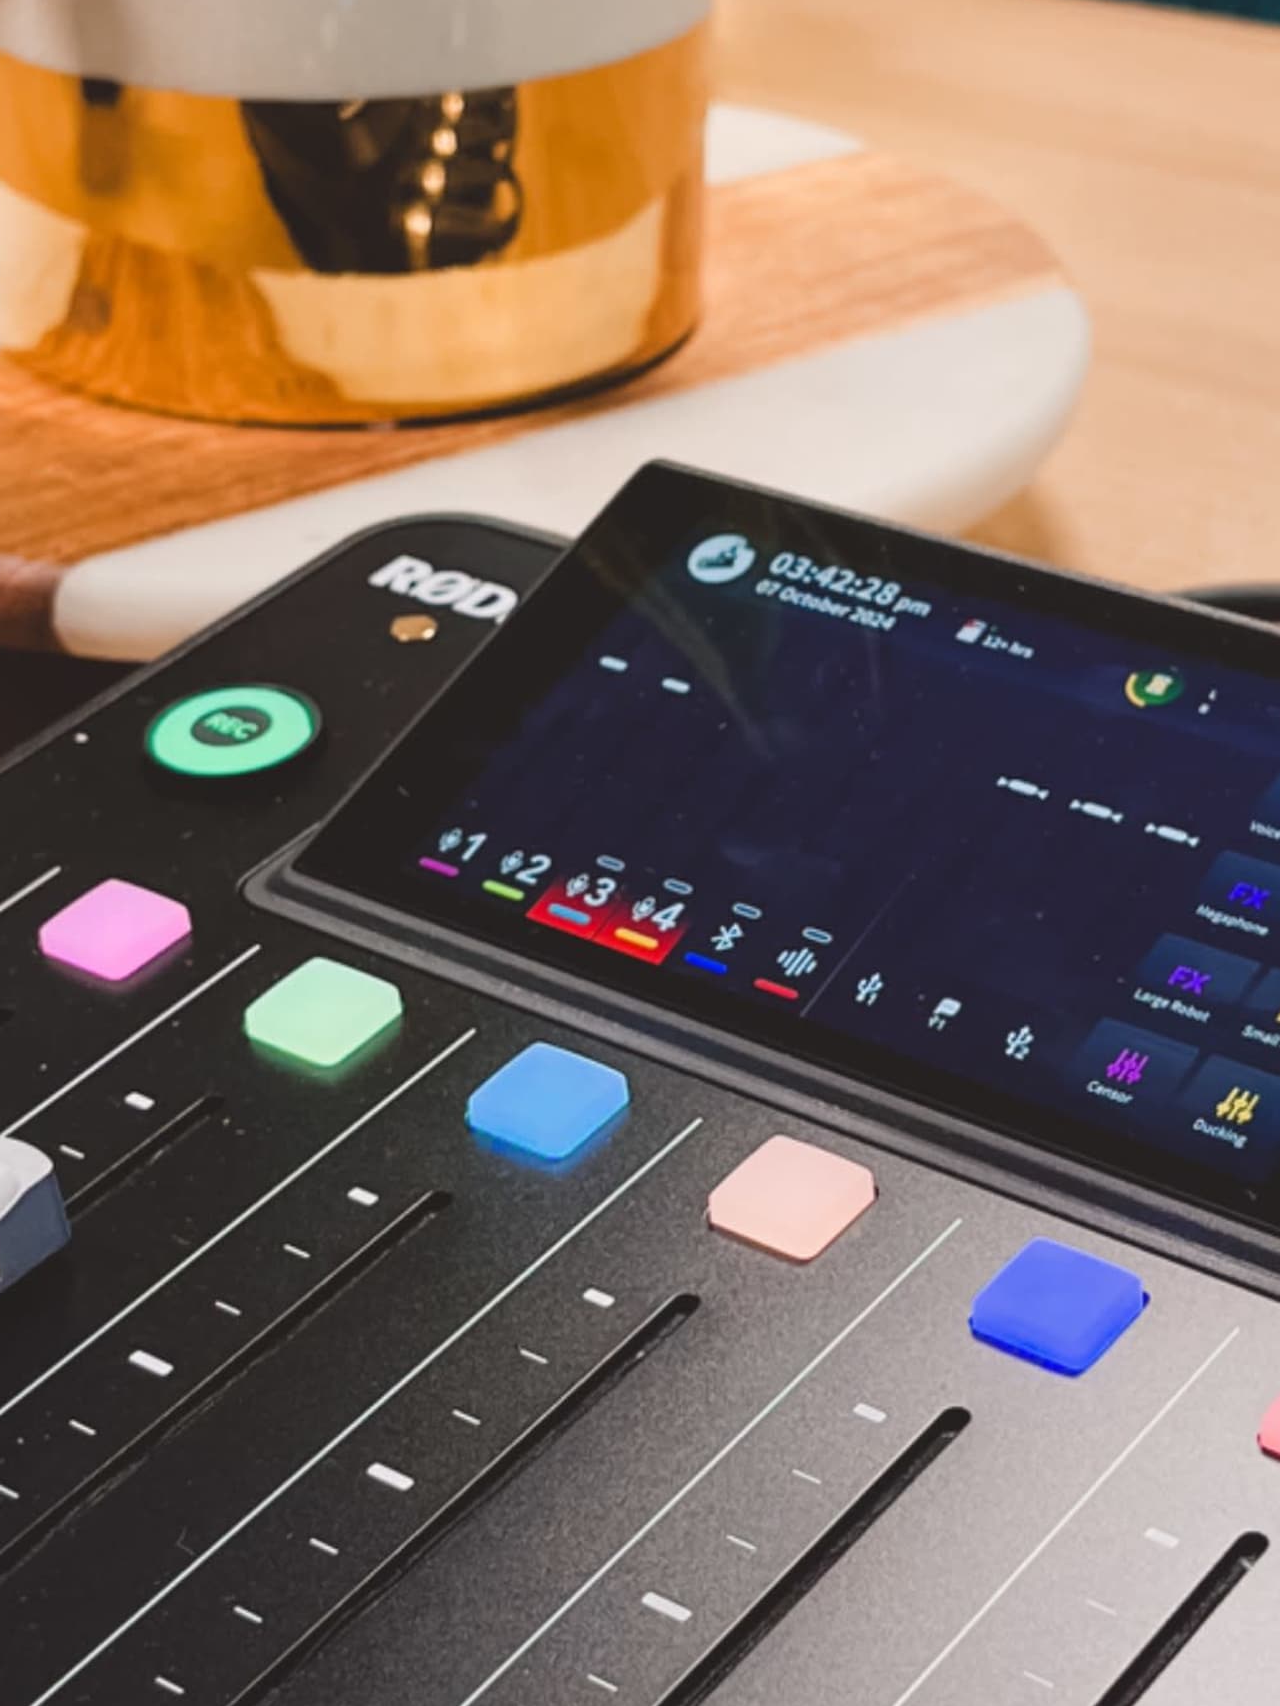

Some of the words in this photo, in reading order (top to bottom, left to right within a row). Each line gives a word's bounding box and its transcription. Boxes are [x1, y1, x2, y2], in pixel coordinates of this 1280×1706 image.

[368, 554, 519, 625] RØD
[769, 552, 901, 606] 03:42:28
[892, 596, 932, 618] pm
[779, 586, 851, 619] October
[851, 606, 897, 631] 2024
[461, 832, 488, 862] 1
[515, 853, 552, 885] 2
[582, 876, 616, 907] 3
[1227, 881, 1270, 910] FX
[651, 901, 686, 933] 4
[1195, 904, 1269, 936] Megaphone
[1168, 964, 1211, 996] FX
[1133, 987, 1170, 1010] Large
[1086, 1080, 1134, 1105] Censor
[1192, 1118, 1248, 1149] Ducking
